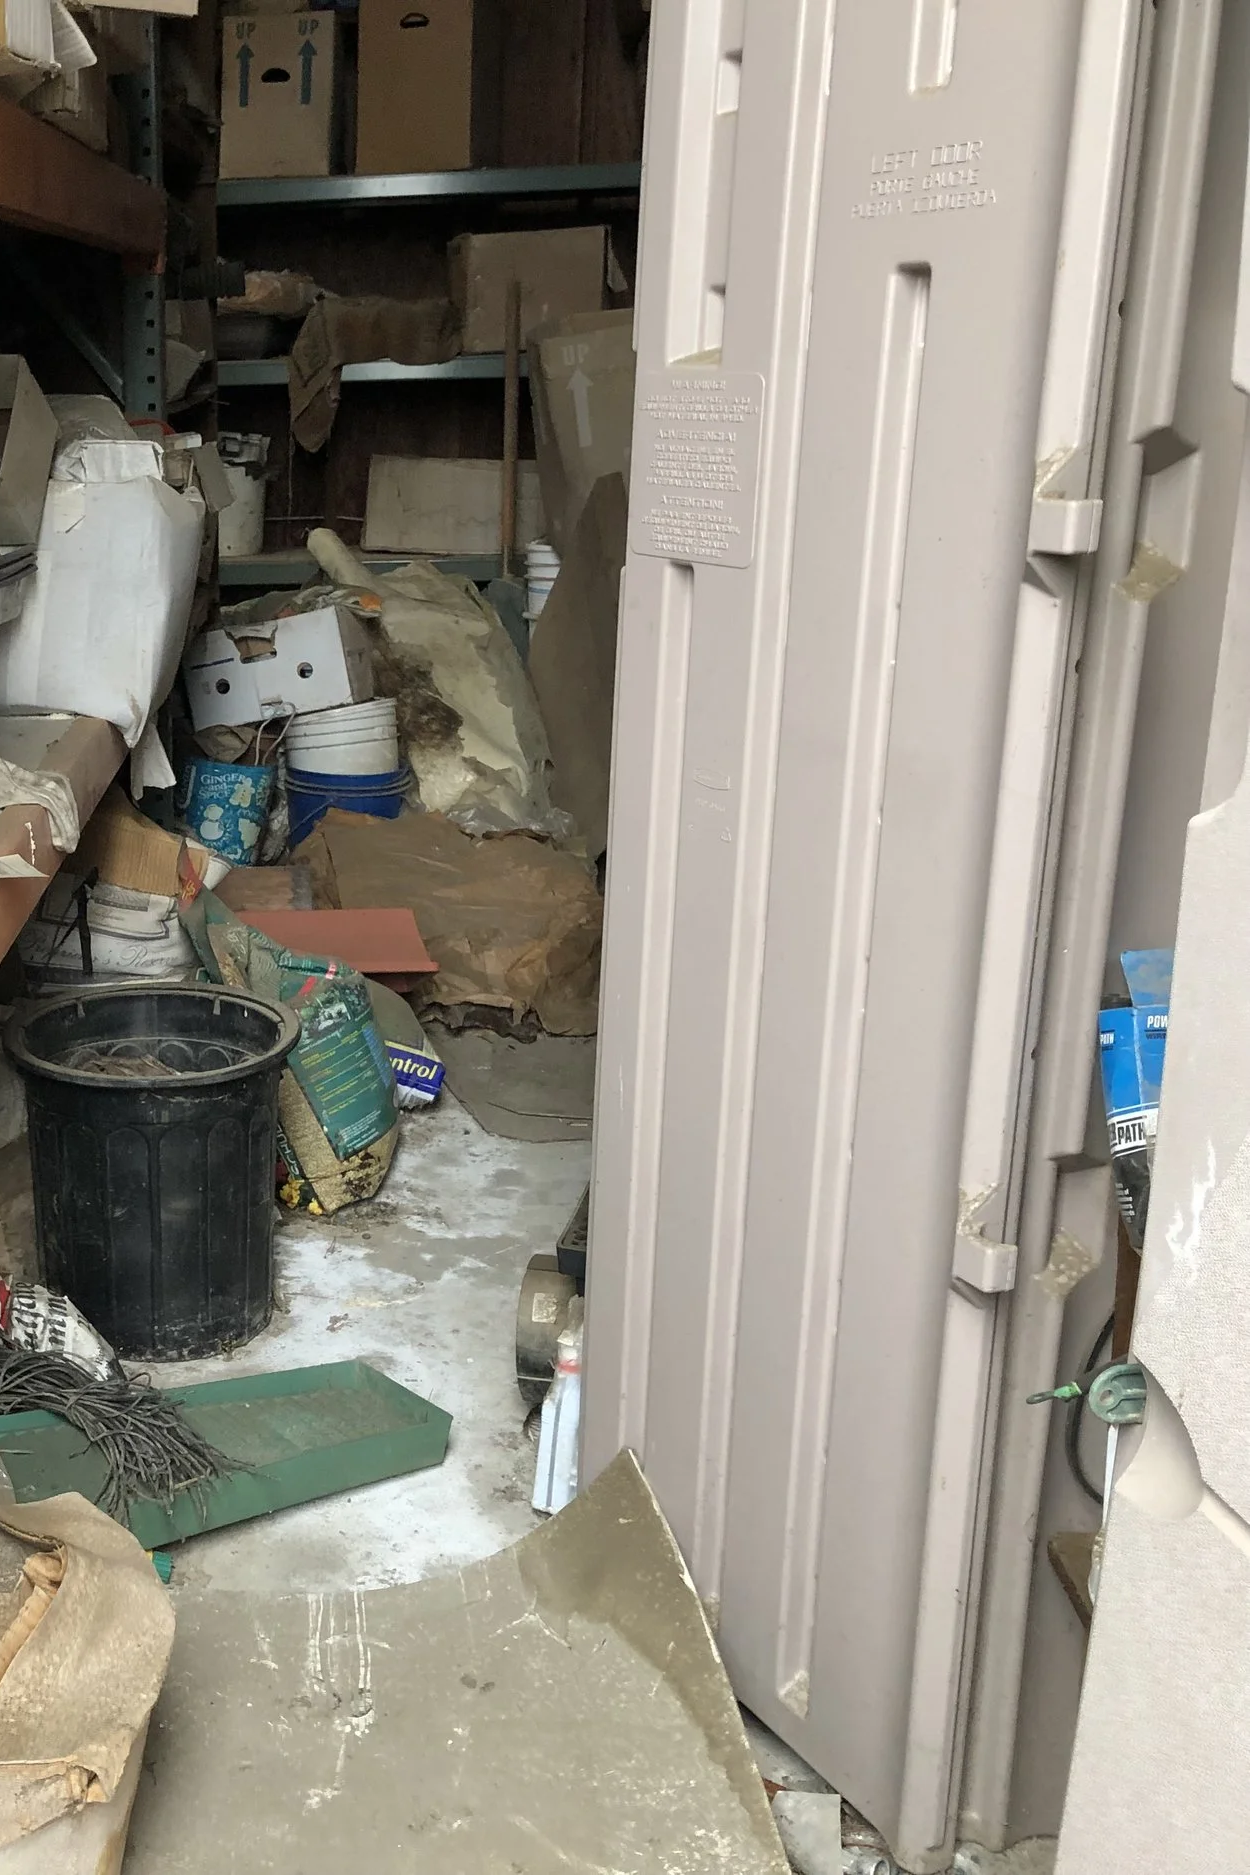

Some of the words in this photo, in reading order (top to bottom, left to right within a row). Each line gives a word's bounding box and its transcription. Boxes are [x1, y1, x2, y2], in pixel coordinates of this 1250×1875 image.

[236, 21, 256, 39] UP
[298, 19, 319, 36] UP
[871, 150, 918, 175] LEFT
[931, 140, 983, 167] DOOR
[560, 345, 589, 367] UP
[389, 1056, 439, 1081] ntrol
[1117, 1121, 1146, 1145] PATH
